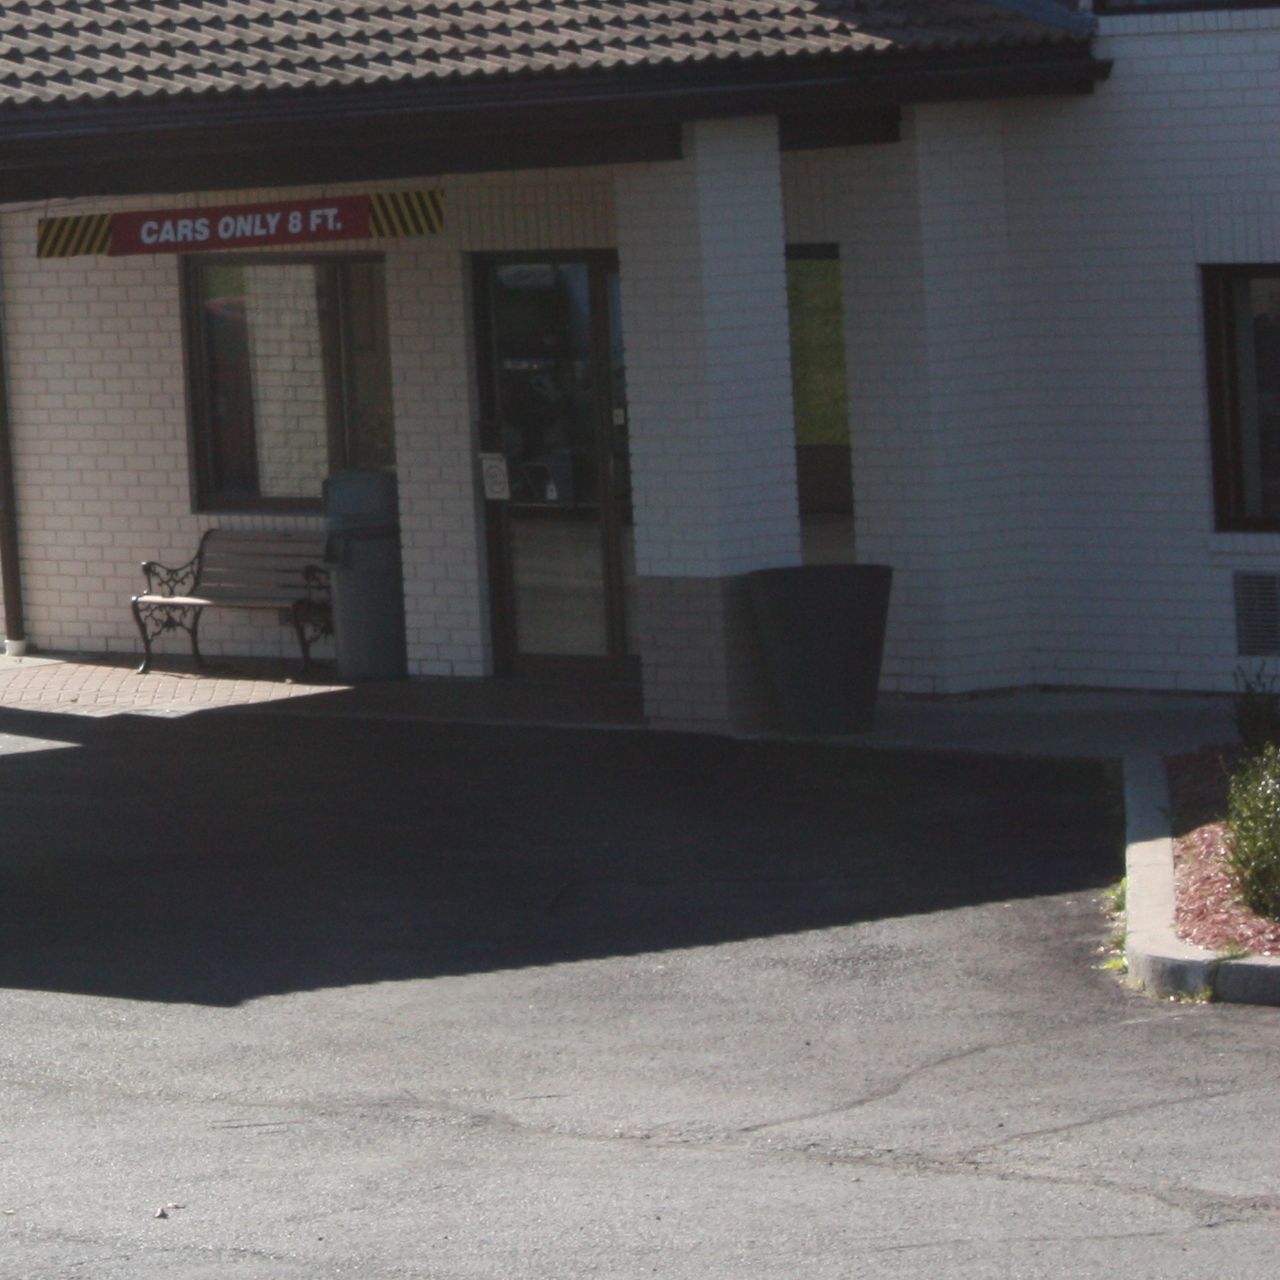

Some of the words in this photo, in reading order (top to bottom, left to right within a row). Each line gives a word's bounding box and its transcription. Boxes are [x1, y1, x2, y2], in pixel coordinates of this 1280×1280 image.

[141, 218, 211, 245] CARS
[218, 213, 282, 240] ONLY
[288, 210, 303, 234] 8
[310, 207, 343, 232] FT.
